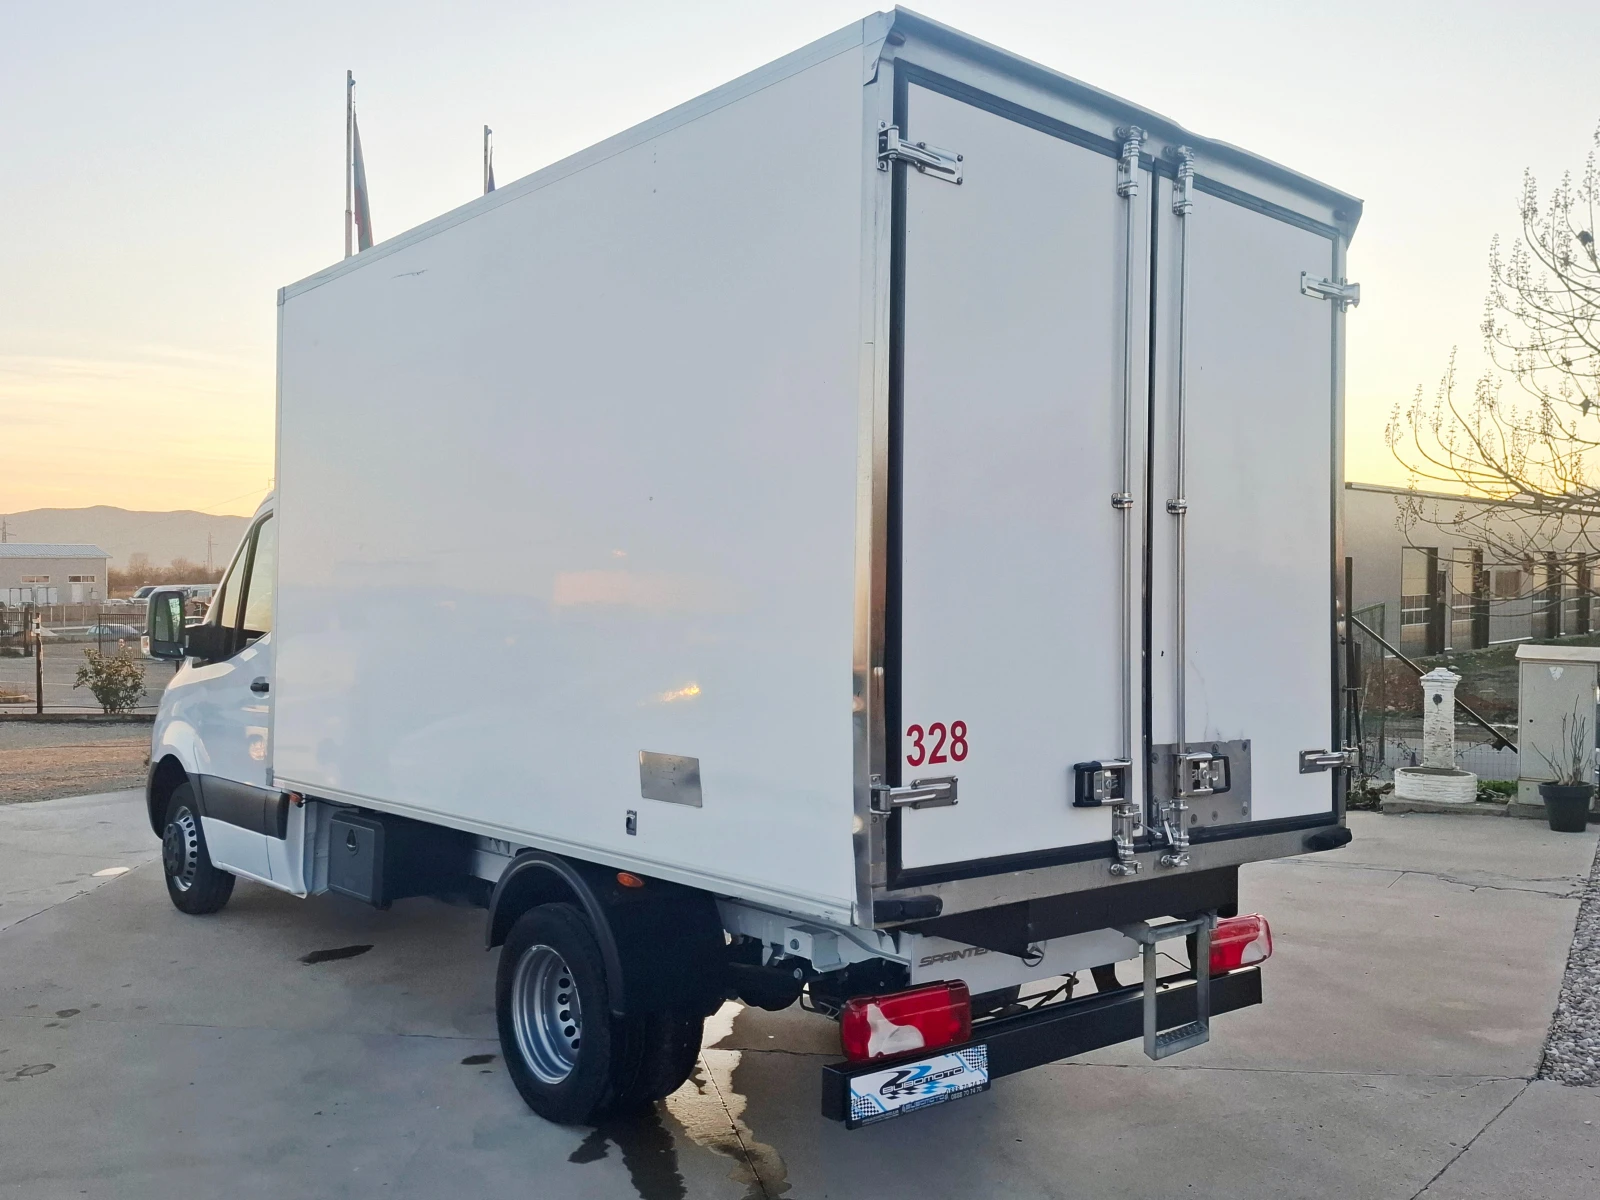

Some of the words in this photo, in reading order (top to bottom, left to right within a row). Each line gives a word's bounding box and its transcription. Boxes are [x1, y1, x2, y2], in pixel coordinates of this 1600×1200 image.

[906, 720, 968, 767] 328
[918, 947, 989, 967] SPRINTE
[882, 1066, 964, 1095] BUBOMOTO
